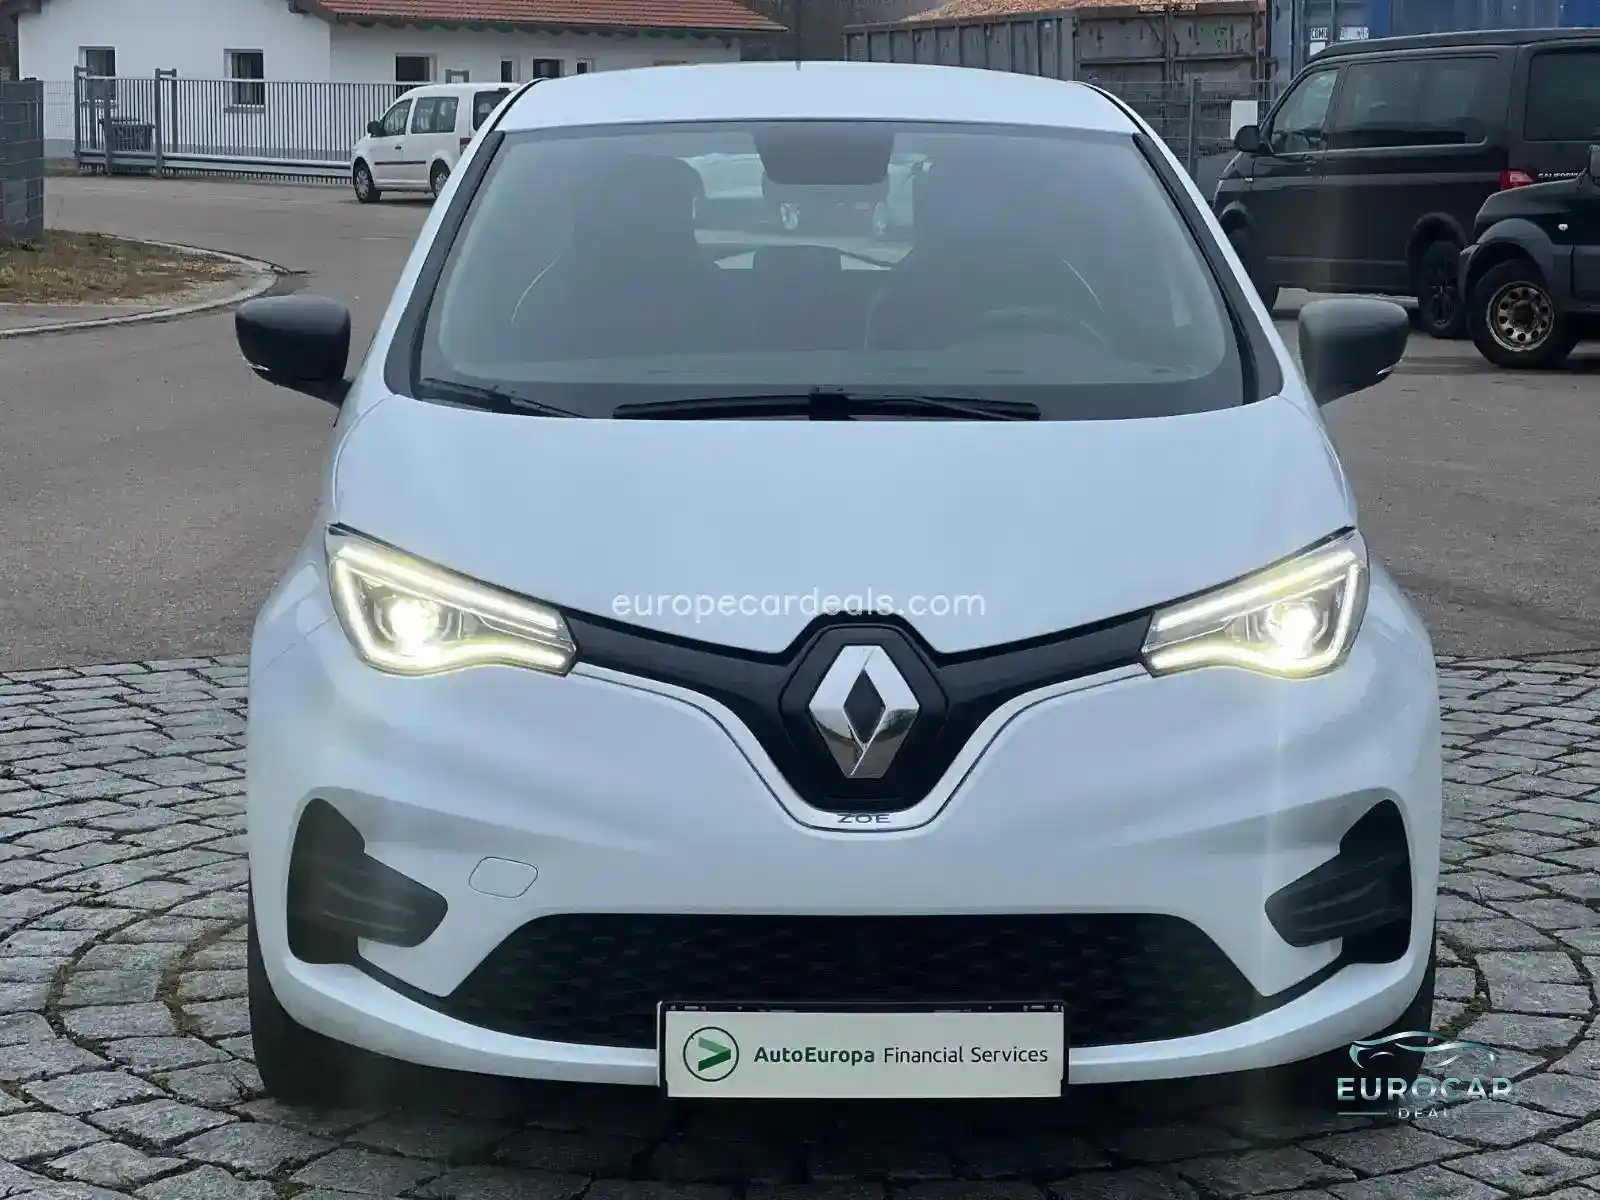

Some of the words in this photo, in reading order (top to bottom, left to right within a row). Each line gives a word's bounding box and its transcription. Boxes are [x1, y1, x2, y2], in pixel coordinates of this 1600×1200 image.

[837, 813, 891, 823] ZOE
[753, 1046, 875, 1066] AutoEuropa
[884, 1046, 964, 1063] Financial
[971, 1046, 1048, 1063] Services
